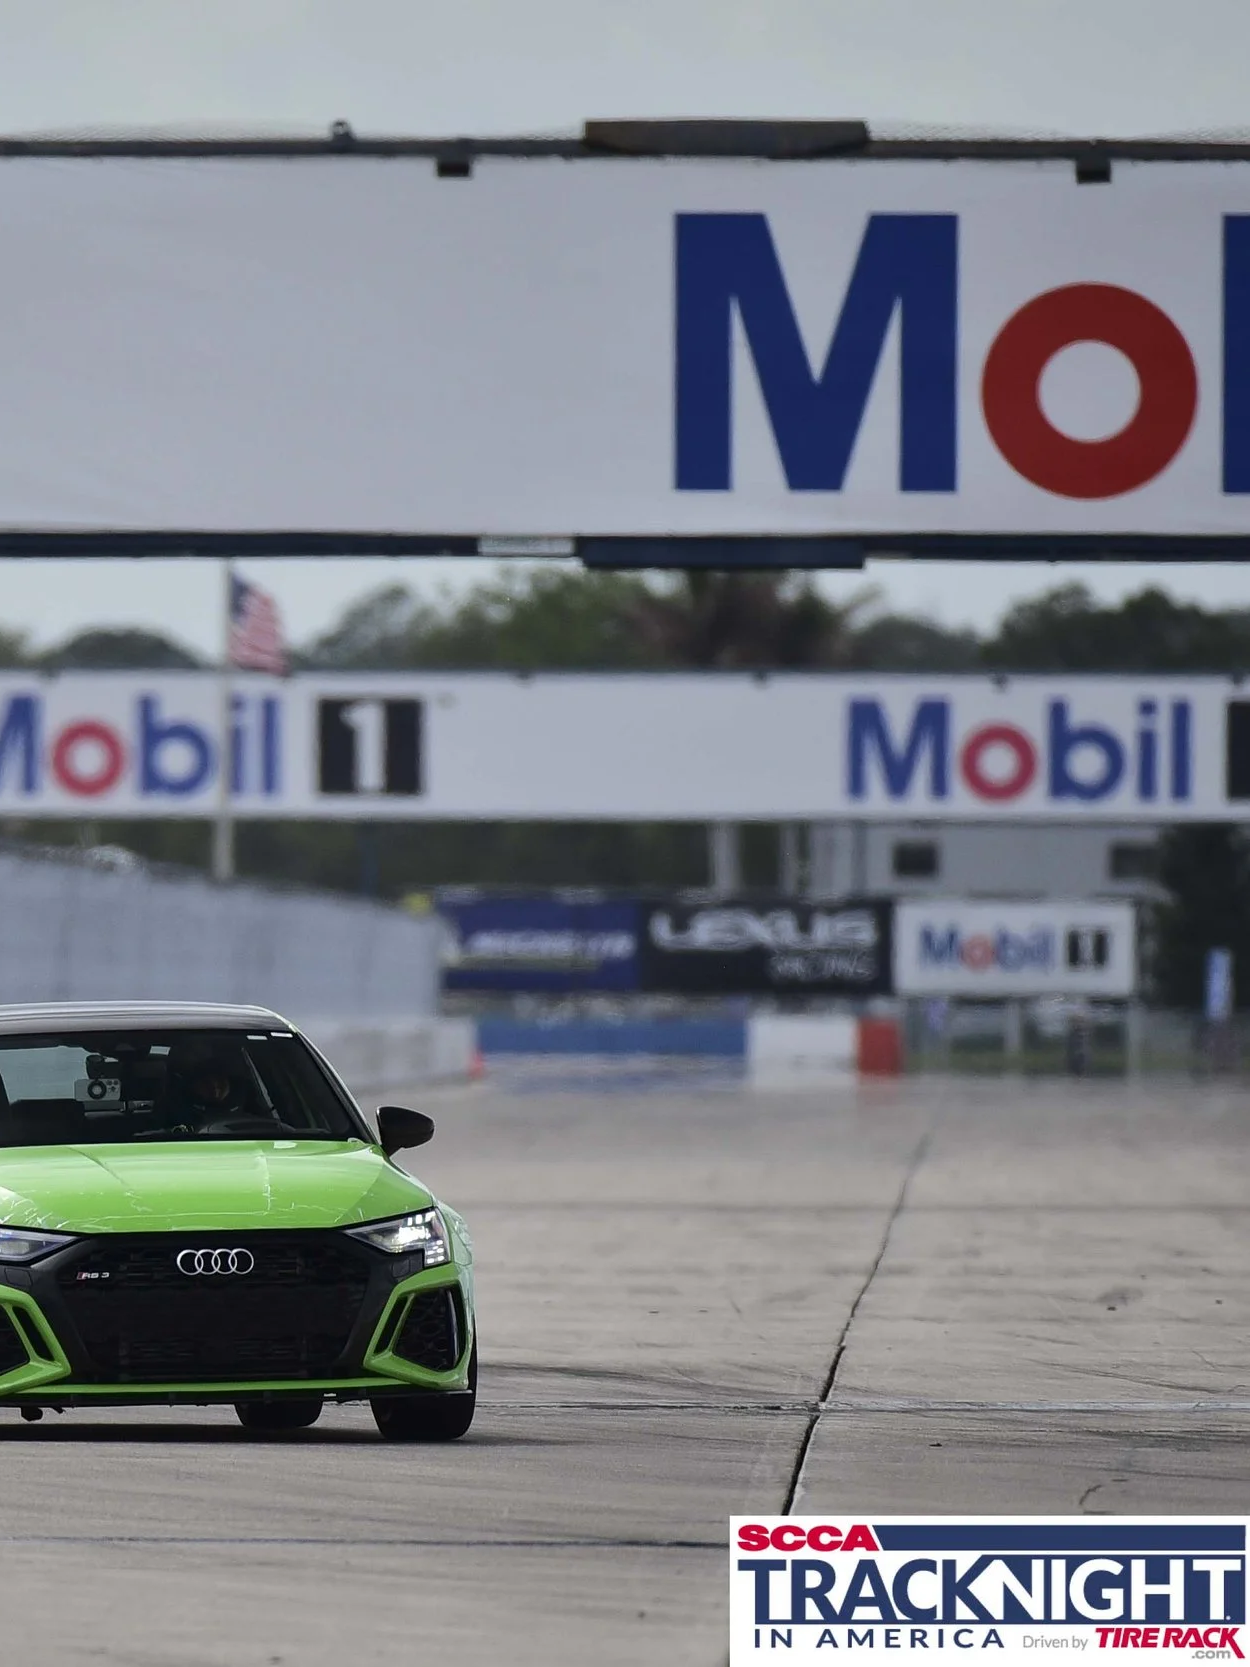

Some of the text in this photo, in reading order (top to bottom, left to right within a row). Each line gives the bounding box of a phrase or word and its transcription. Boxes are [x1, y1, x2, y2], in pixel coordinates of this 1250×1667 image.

[674, 212, 1250, 500] Mo
[847, 695, 1192, 802] Mobil
[650, 910, 877, 950] LEXUS
[920, 923, 1054, 972] Mobil
